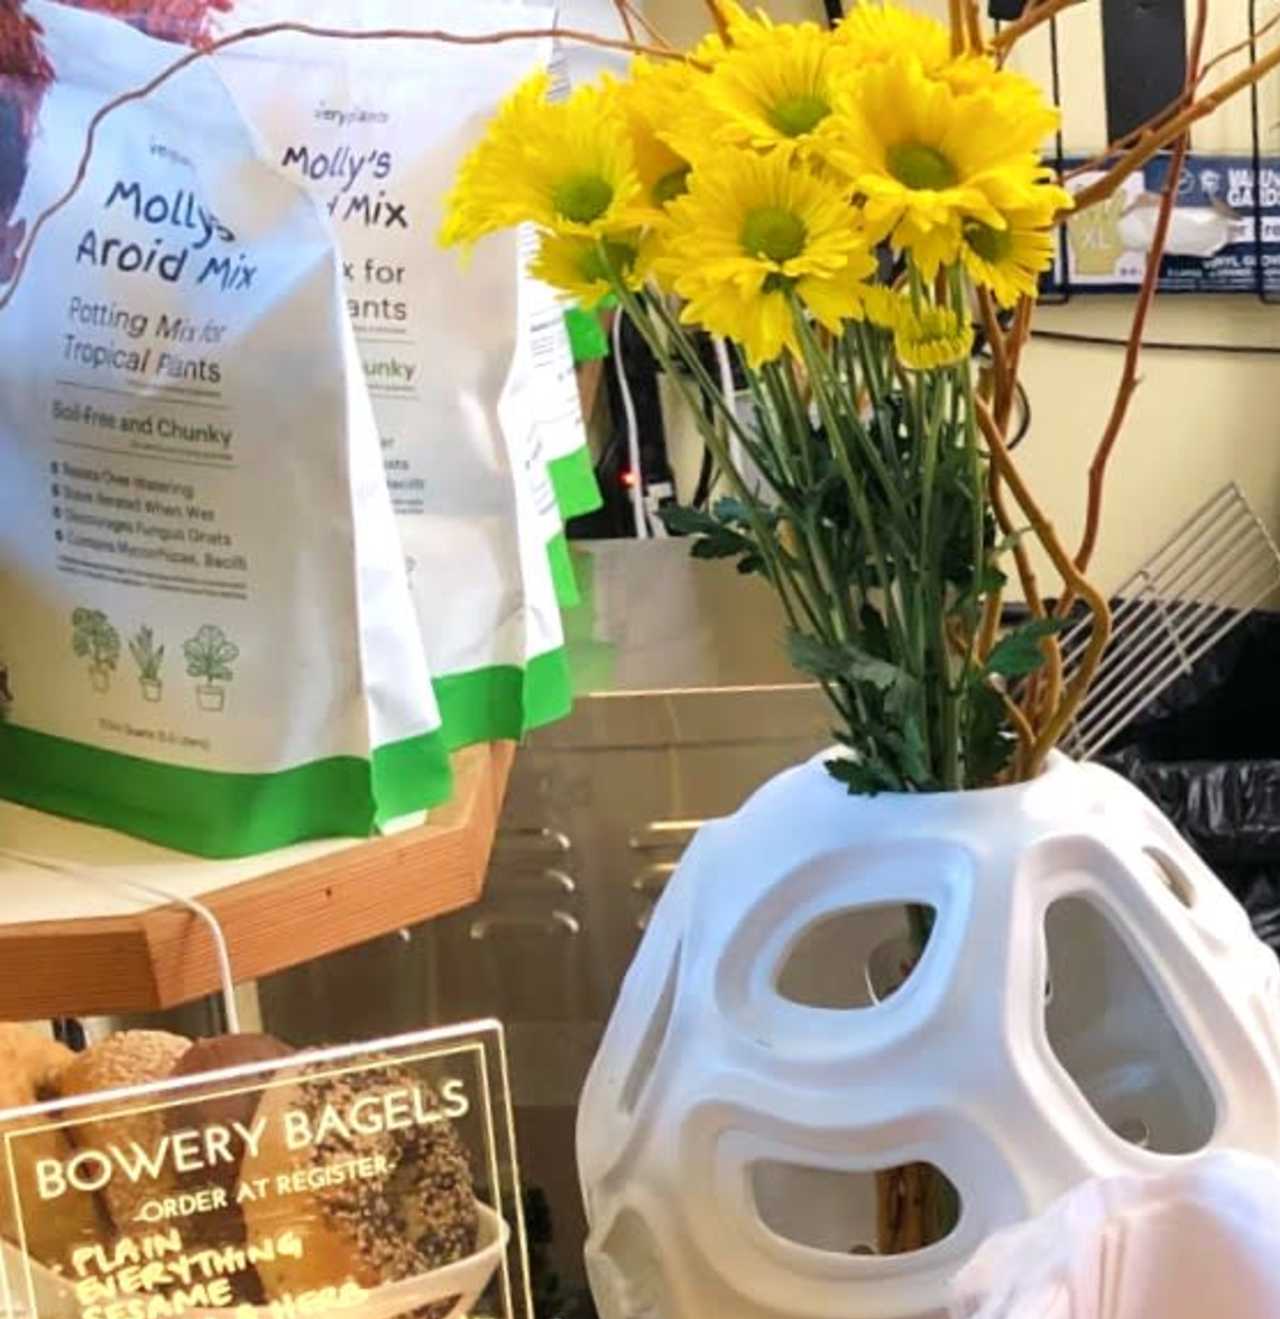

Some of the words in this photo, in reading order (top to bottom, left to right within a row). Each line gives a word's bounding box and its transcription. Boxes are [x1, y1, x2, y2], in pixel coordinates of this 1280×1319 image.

[282, 146, 392, 193] Molly's
[343, 190, 408, 228] Mix
[76, 229, 189, 282] Aroid
[197, 253, 259, 291] Mix
[364, 259, 406, 284] for
[69, 297, 148, 338] Potting
[348, 299, 407, 321] ants
[62, 334, 151, 373] Tropical
[364, 357, 416, 381] unky
[156, 417, 232, 448] Chunky
[35, 1118, 268, 1200] BOWERY
[283, 1079, 470, 1152] BAGELS
[236, 1177, 270, 1202] AT
[70, 1228, 183, 1277] PLAIN
